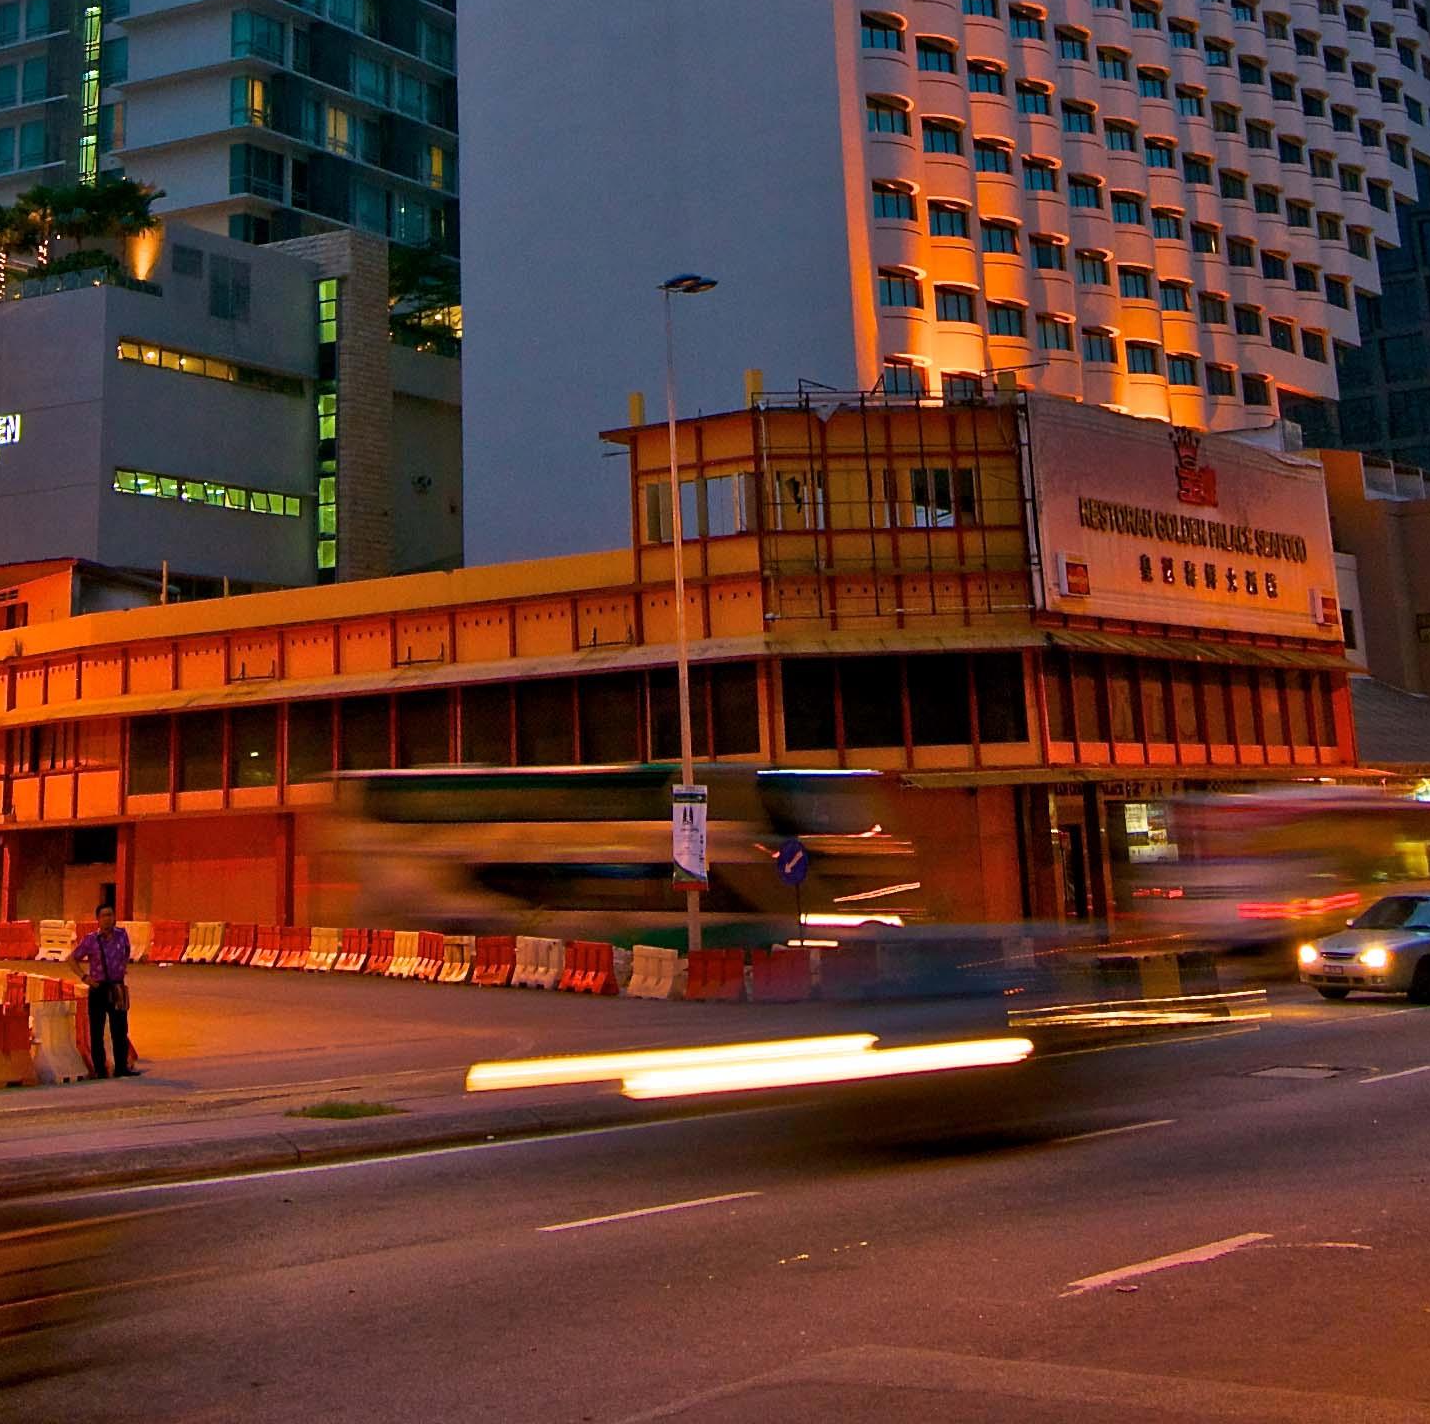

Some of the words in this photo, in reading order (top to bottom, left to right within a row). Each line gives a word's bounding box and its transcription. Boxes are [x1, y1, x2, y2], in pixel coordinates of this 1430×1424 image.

[1079, 496, 1153, 538] RESTORAN
[1154, 511, 1208, 548] GOLDEN
[1208, 520, 1254, 555] PALACE
[1254, 529, 1308, 564] SEAFOOD
